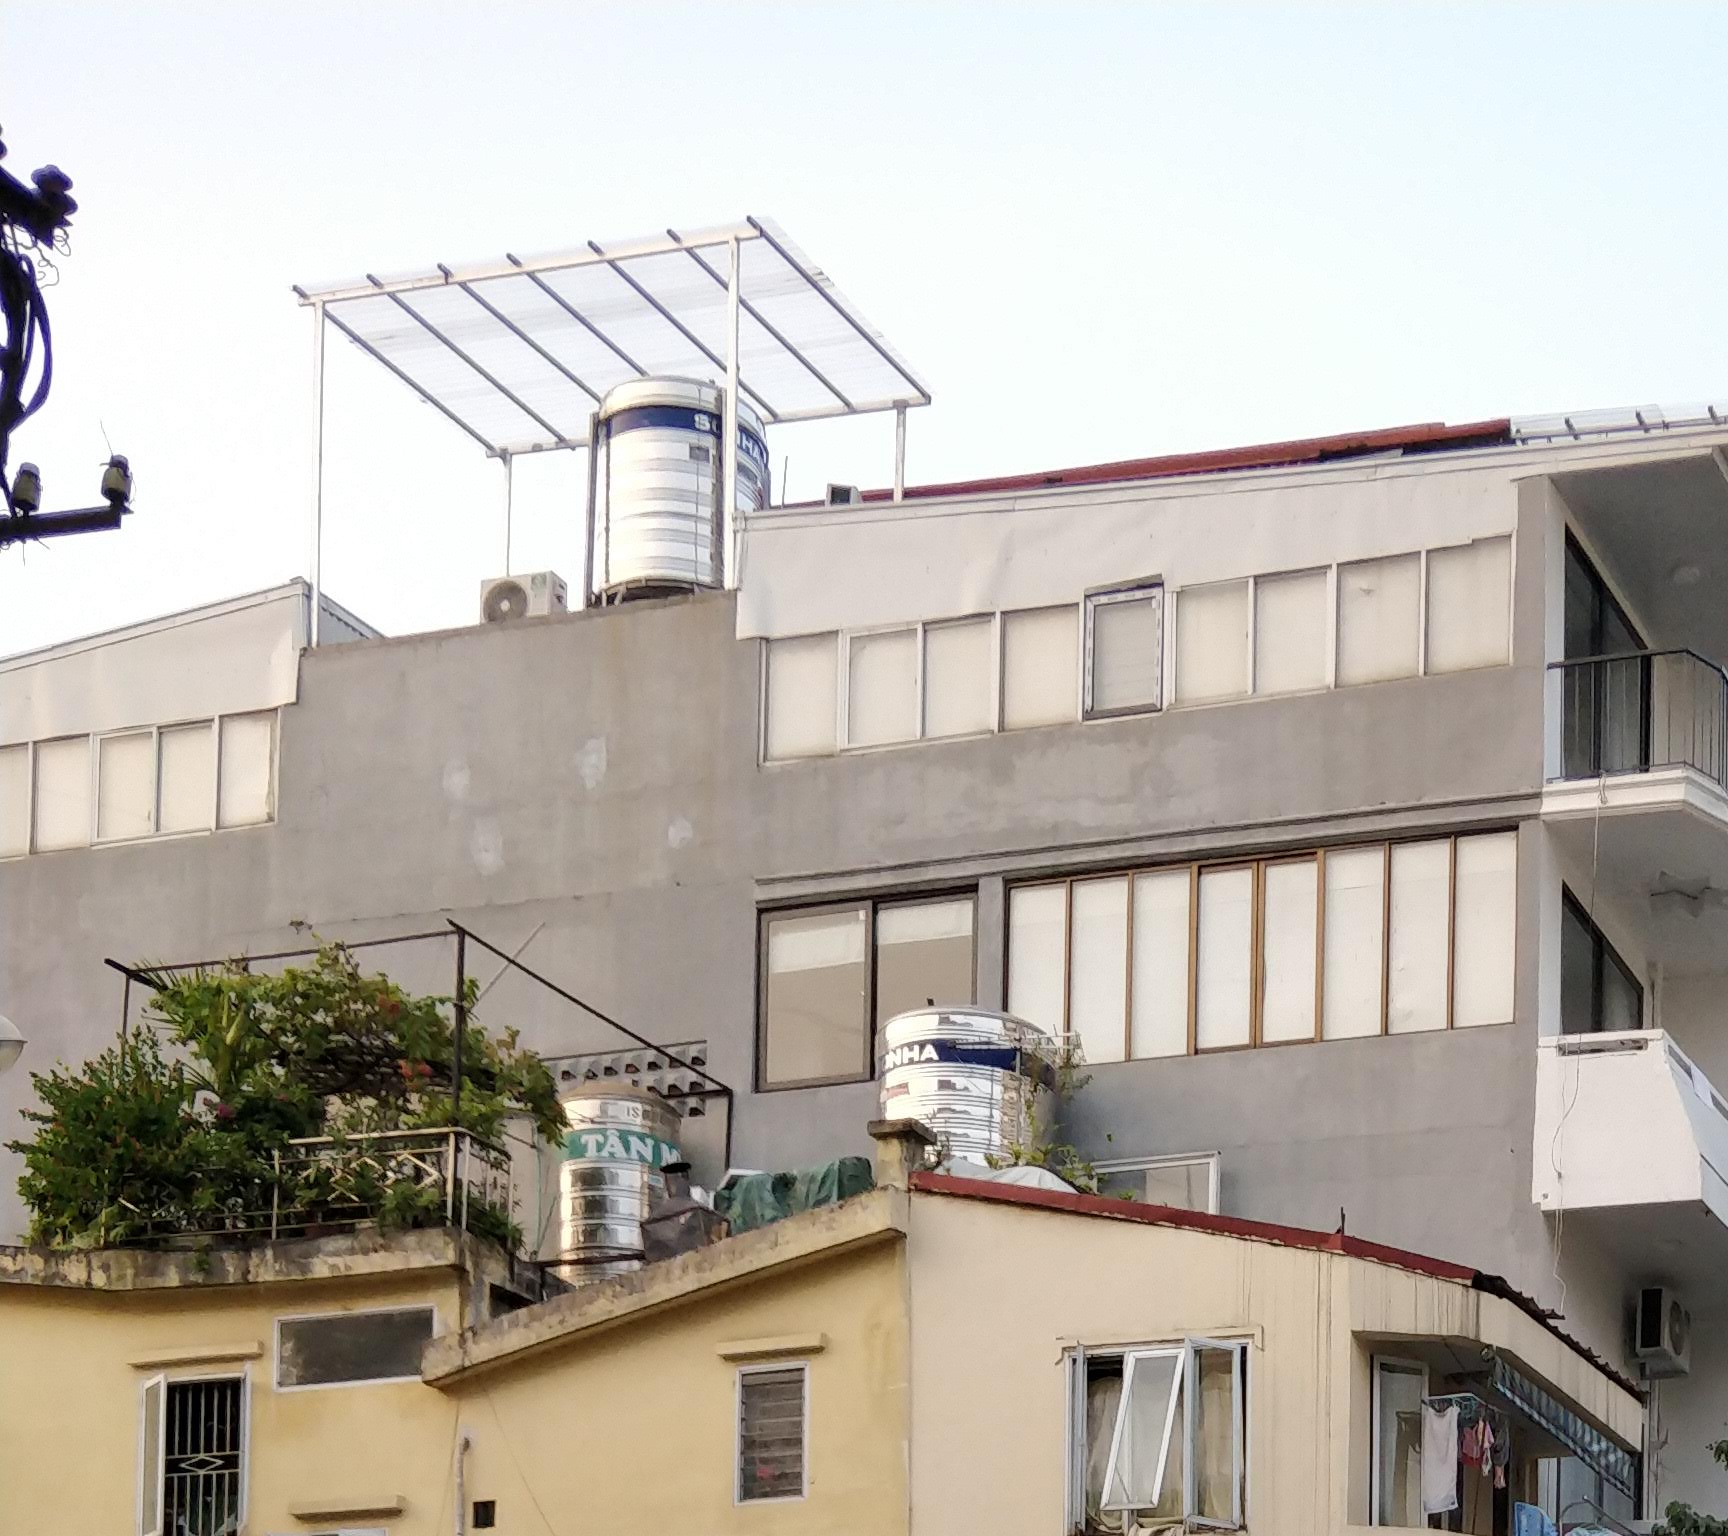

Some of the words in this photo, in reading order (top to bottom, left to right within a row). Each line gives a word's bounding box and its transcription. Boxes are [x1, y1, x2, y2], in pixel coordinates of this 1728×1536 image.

[884, 1043, 940, 1069] NHA
[580, 1129, 655, 1162] TÂN
[660, 1142, 682, 1166] M
